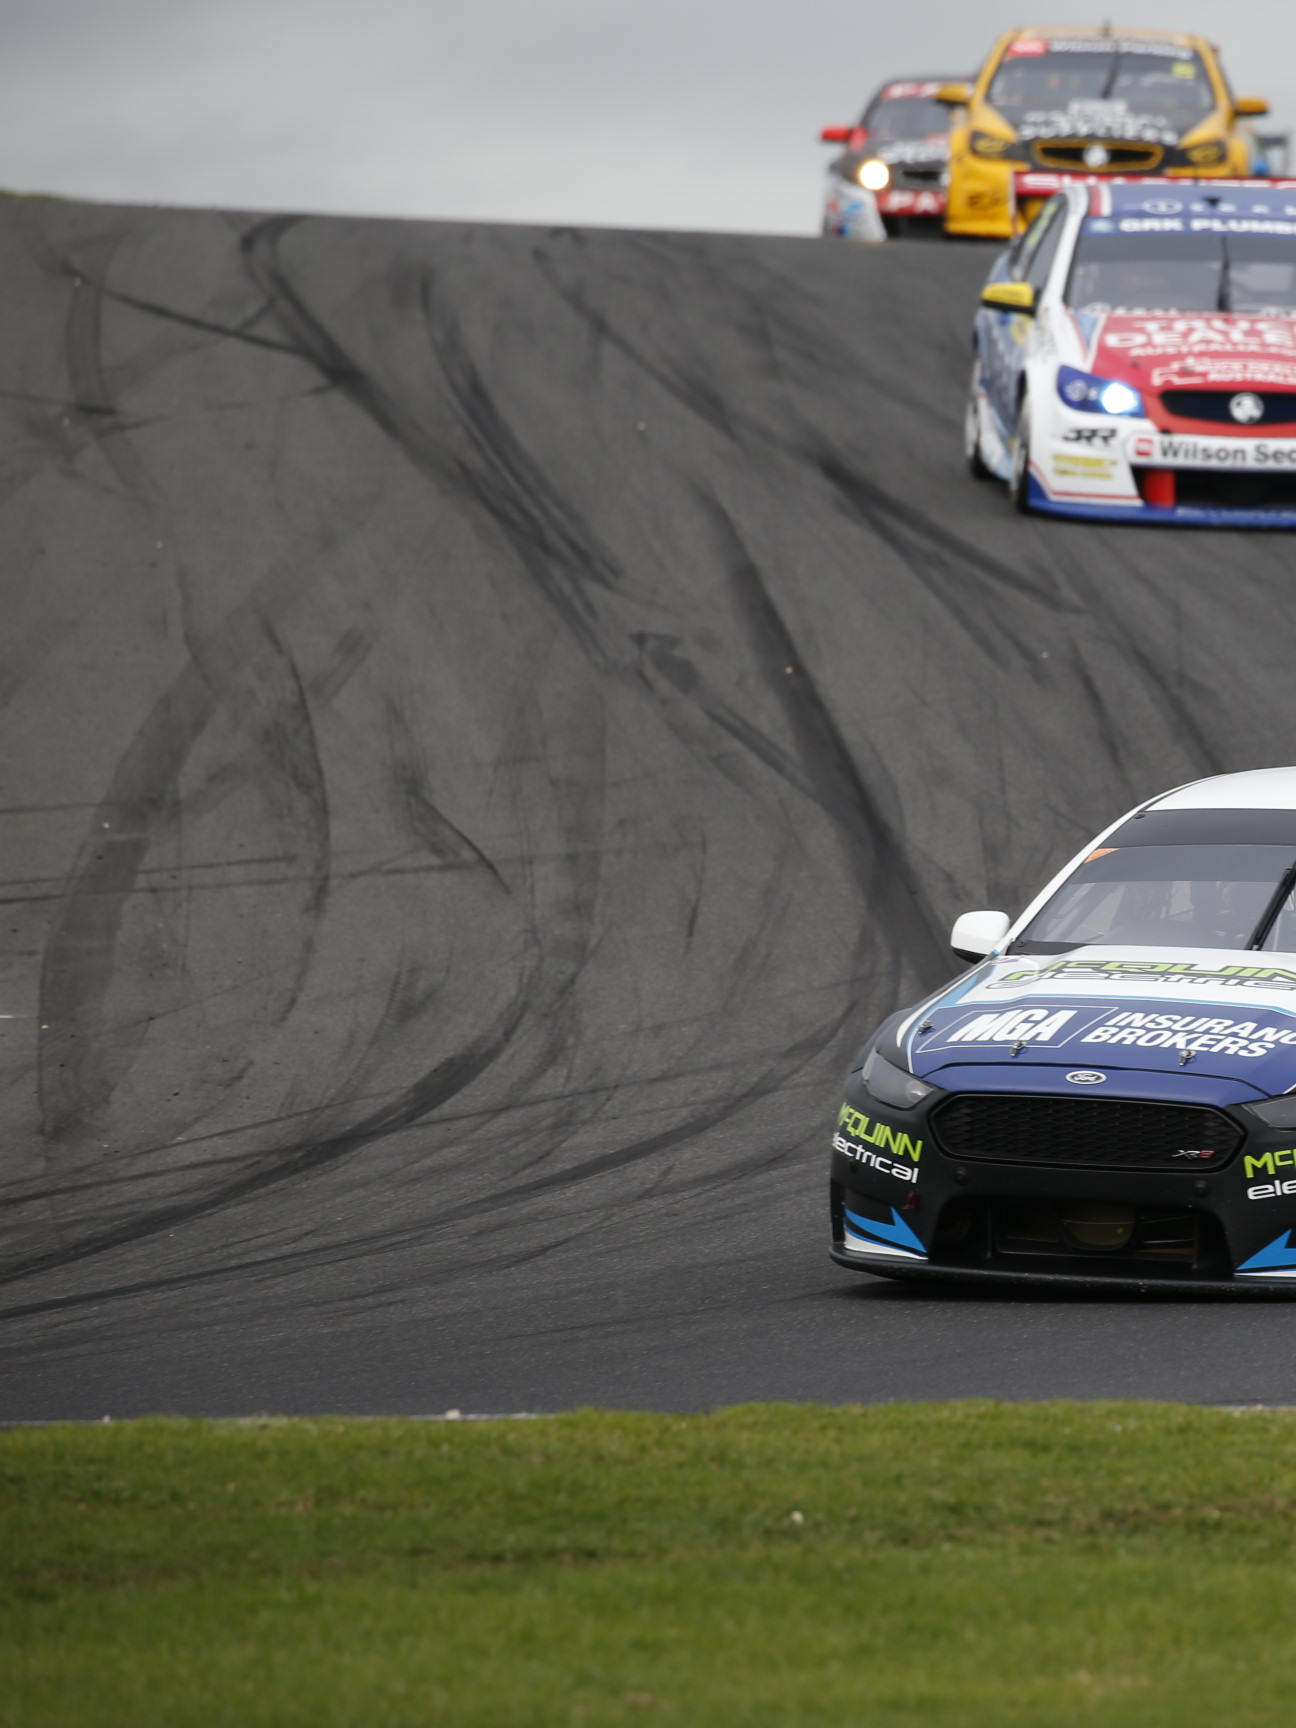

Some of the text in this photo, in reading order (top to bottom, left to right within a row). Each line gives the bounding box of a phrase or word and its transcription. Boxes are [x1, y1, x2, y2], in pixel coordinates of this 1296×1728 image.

[1160, 437, 1248, 462] Wilson
[945, 1008, 1081, 1044] MGA
[1081, 1027, 1278, 1059] BROKERS
